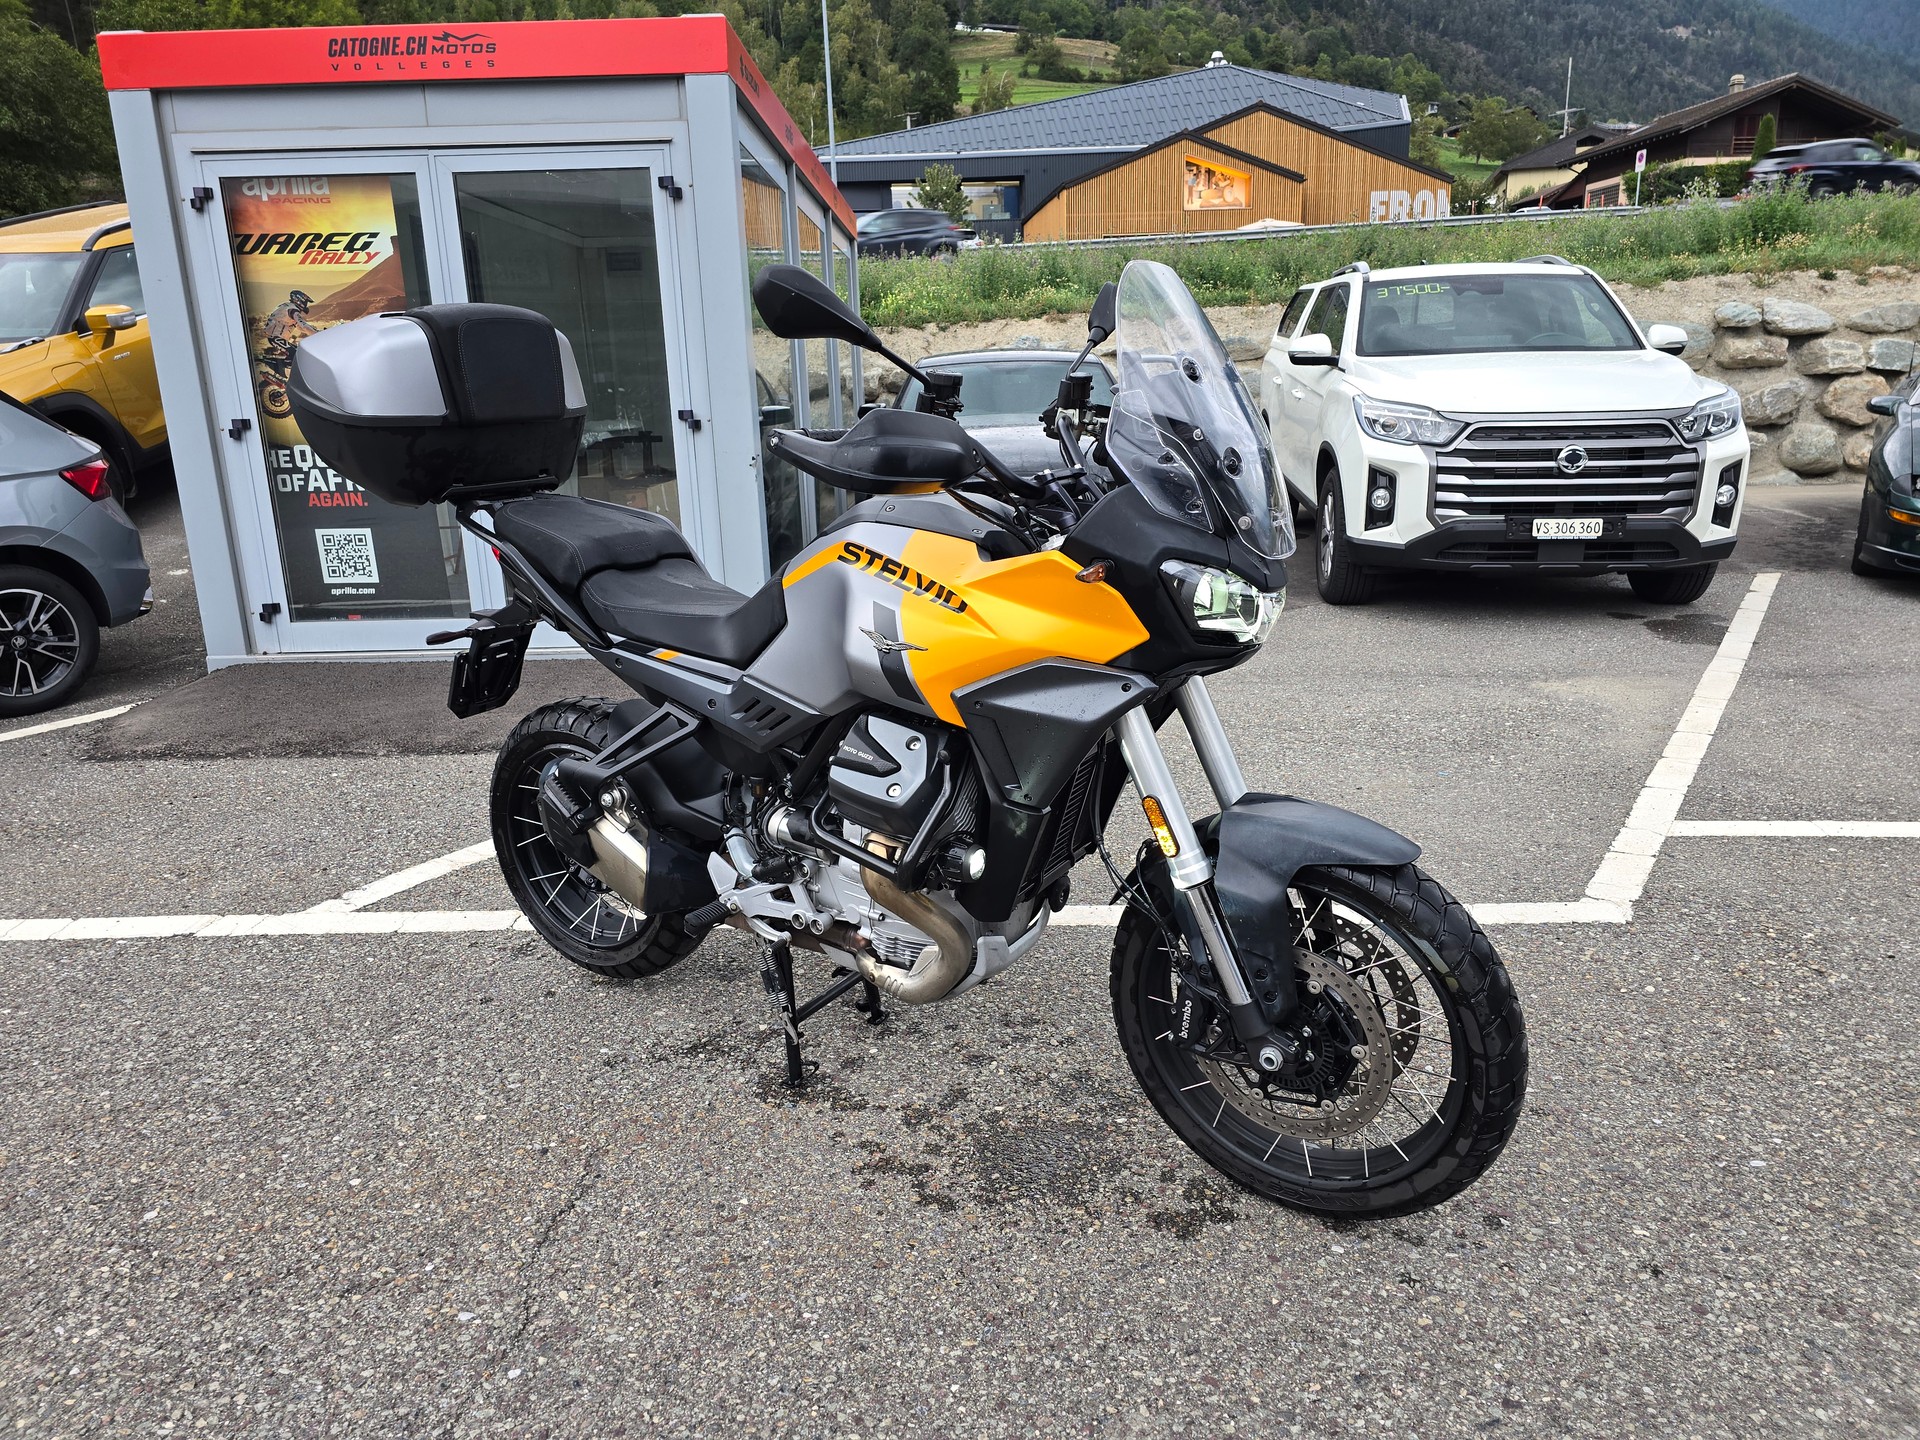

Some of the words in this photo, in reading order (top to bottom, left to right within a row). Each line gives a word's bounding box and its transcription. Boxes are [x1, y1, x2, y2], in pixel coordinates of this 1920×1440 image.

[328, 36, 428, 58] CATOGNE.CH
[431, 43, 497, 55] MOTOS
[331, 60, 495, 71] VOLLEGES
[234, 232, 381, 255] UAREG
[298, 250, 381, 265] RALLY
[269, 450, 293, 468] HE
[276, 474, 305, 492] OF
[308, 492, 369, 507] AGAIN.
[836, 541, 969, 614] STELVIO
[331, 586, 376, 596] aprilia.com
[842, 744, 858, 754] MOTO
[1178, 1000, 1193, 1039] brembo
